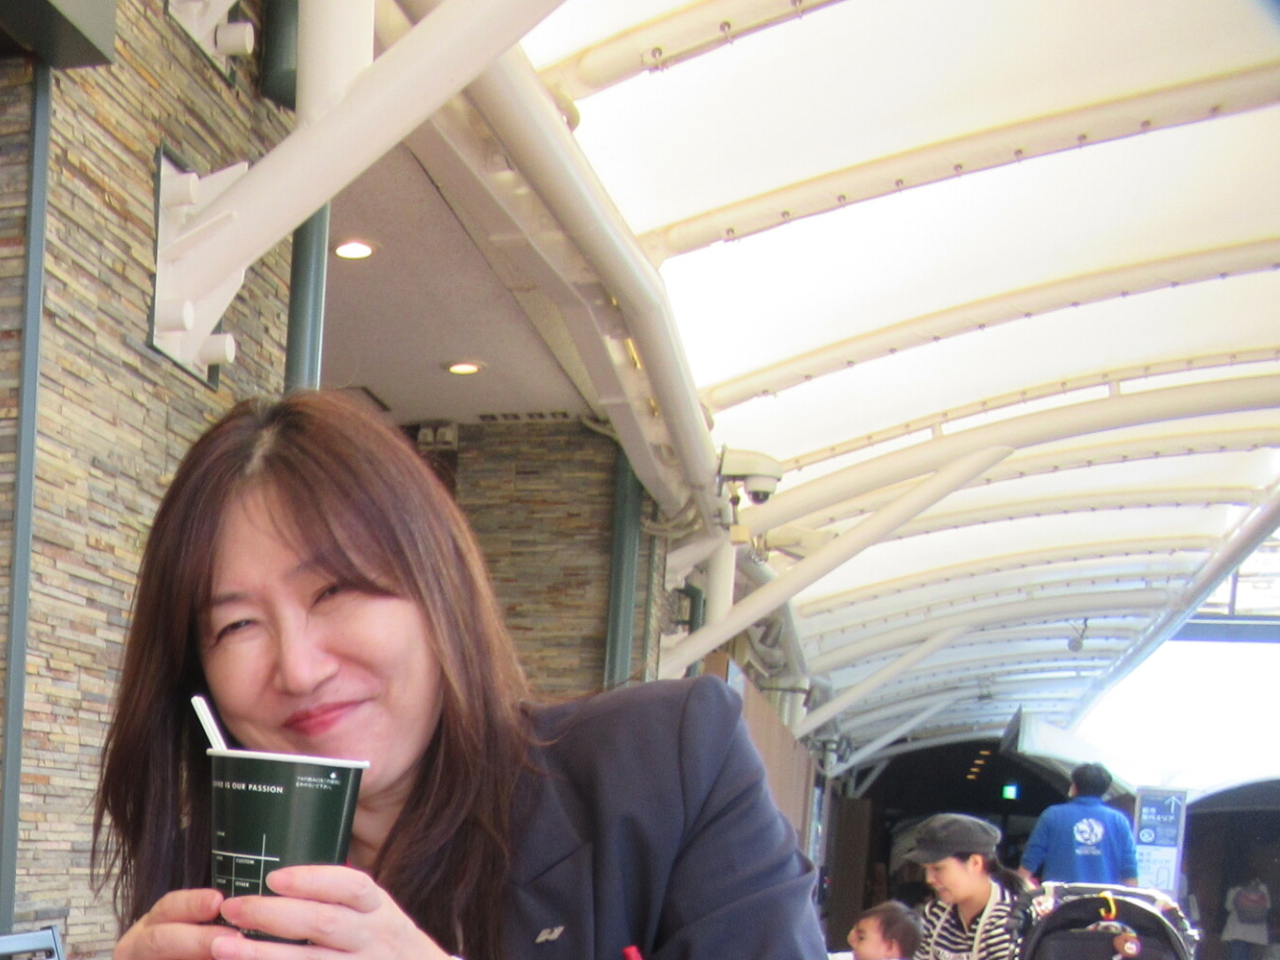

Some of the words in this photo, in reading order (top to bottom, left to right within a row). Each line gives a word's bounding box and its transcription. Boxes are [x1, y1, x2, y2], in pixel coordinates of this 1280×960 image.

[224, 781, 231, 789] IS
[232, 782, 246, 791] OUR
[248, 784, 284, 794] PASSION
